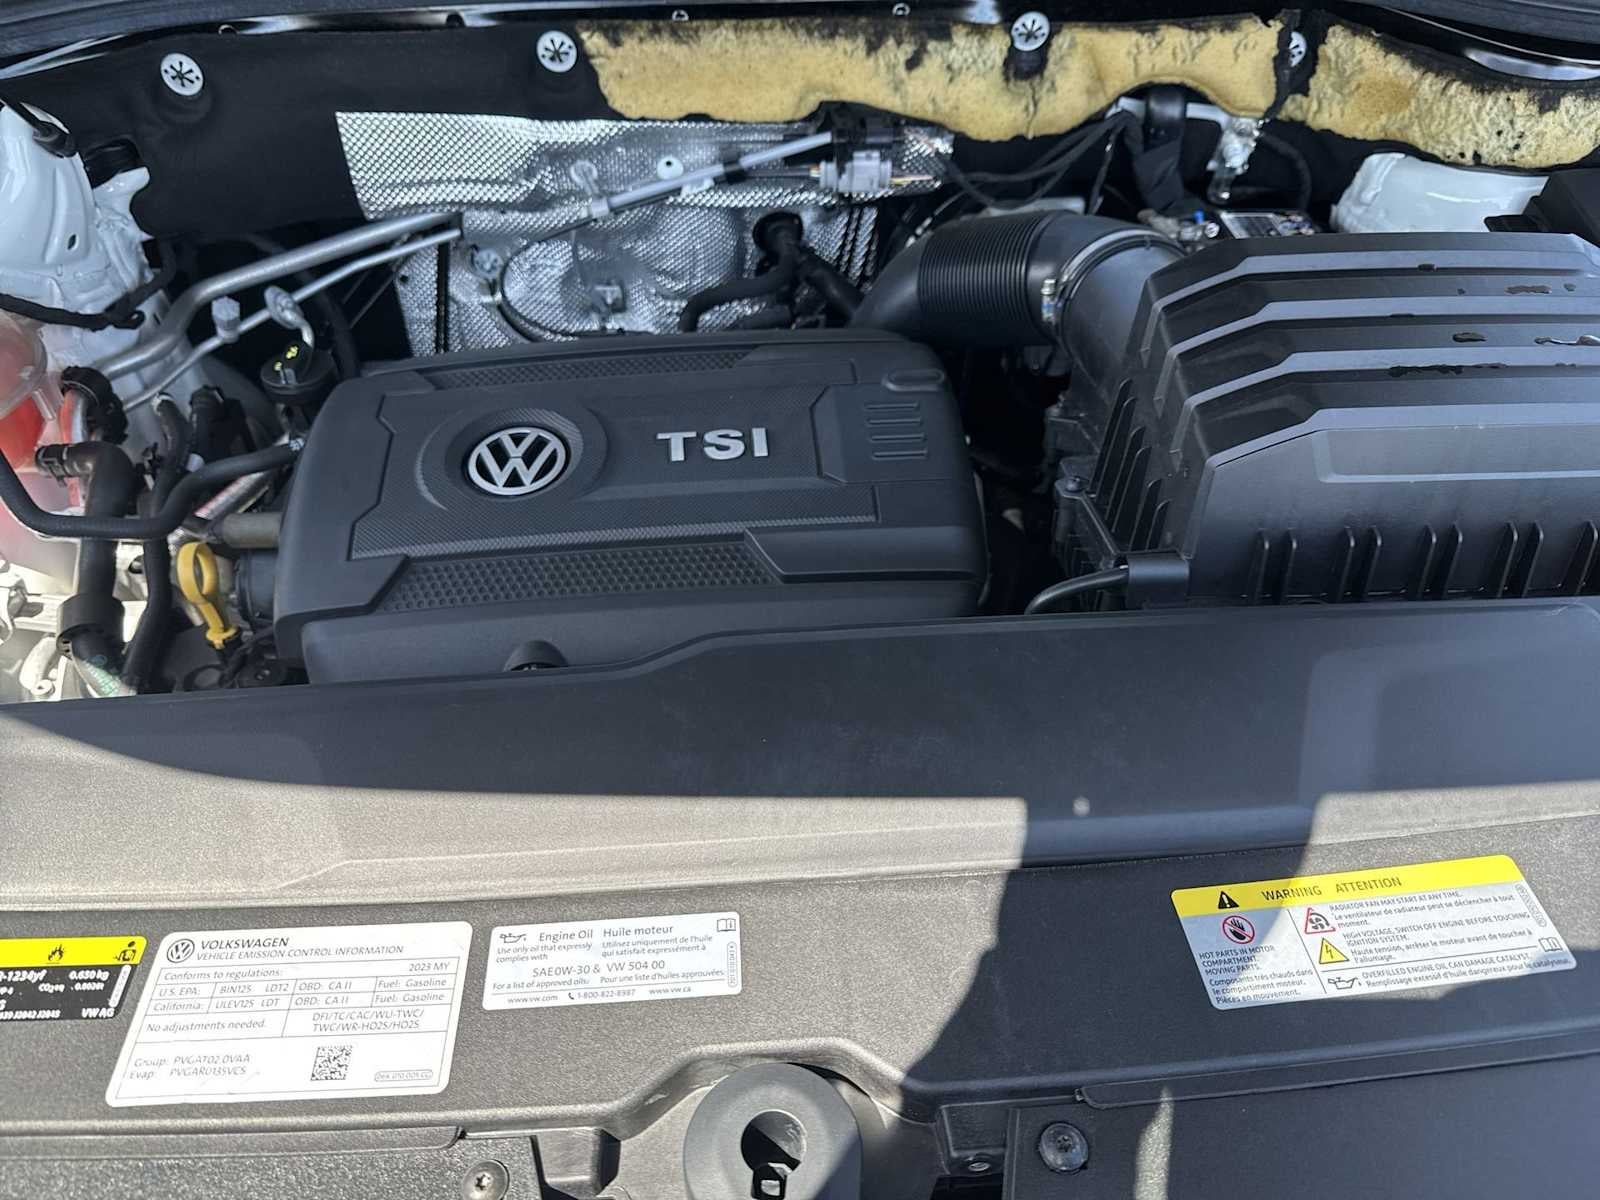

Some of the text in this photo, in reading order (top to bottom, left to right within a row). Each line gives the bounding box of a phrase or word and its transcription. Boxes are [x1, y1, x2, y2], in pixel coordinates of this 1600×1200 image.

[656, 427, 768, 461] TSI
[1261, 877, 1402, 901] WARNING ATTENTION
[1329, 890, 1462, 912] RADIATOR FAN MAY START AT ANY TIME.
[1343, 909, 1382, 920] ventilateur
[1394, 904, 1427, 914] radiateur
[1427, 903, 1445, 912] peut
[1454, 897, 1492, 907] déclencher
[1500, 894, 1515, 902] tout
[603, 925, 674, 937] Huile moteur
[1337, 920, 1370, 929] moment.
[1344, 932, 1359, 940] HIGH
[1396, 924, 1423, 934] SWITCH
[1424, 922, 1437, 931] OFF
[1438, 919, 1464, 929] ENGINE
[1465, 915, 1492, 926] BEFORE
[1493, 911, 1530, 922] TOUCHING
[539, 929, 593, 943] Engine Oil
[602, 935, 713, 949] Utilisez uniquement de l'huile
[1347, 935, 1409, 947] IGNITION SYSTEM.
[201, 937, 289, 950] VOLKSWAGEN
[497, 942, 593, 955] Use only oil that expressly
[1350, 949, 1373, 957] Haute
[1374, 945, 1404, 955] tension,
[1405, 941, 1431, 951] arrêter
[1439, 937, 1465, 946] moteur
[1467, 935, 1487, 943] avant
[1488, 933, 1497, 941] de
[1498, 930, 1526, 940] toucher
[197, 945, 404, 961] VEHICLE EMISSION CONTROL INFORMATION
[602, 943, 707, 958] qui satisfait expressément à
[1199, 951, 1214, 960] HOT
[1215, 949, 1239, 958] PARTS
[1249, 945, 1275, 954] MOTOR
[496, 953, 549, 965] complies with
[1362, 952, 1530, 978] OVERFILLED ENGINE OIL CAN DAMAGE CATALYST.
[409, 961, 450, 972] 2023 MY
[592, 964, 601, 974] &
[606, 962, 625, 973] VW
[628, 961, 649, 971] 504
[651, 960, 666, 970] 00
[96, 969, 110, 982] kg
[164, 970, 211, 981] Conforms
[213, 970, 224, 979] to
[600, 976, 617, 984] Pour
[618, 974, 634, 983] une
[635, 973, 650, 981] liste
[651, 971, 680, 981] d'huiles
[1209, 975, 1254, 987] Composants
[1269, 970, 1295, 980] chauds
[1295, 968, 1313, 976] dans
[219, 982, 289, 995] BIN125 LDT2
[298, 982, 323, 992] OBD:
[328, 980, 343, 991] CA
[378, 978, 447, 989] Fuel: Gasoline
[492, 982, 504, 990] For
[513, 981, 525, 989] list
[526, 980, 534, 988] of
[535, 979, 572, 990] approved
[1212, 979, 1307, 996] le compartiment moteur.
[215, 999, 255, 1010] ULEV125
[261, 998, 280, 1008] LDT
[294, 996, 321, 1006] OBD:
[324, 995, 339, 1005] CA
[375, 993, 445, 1004] Fuel: Gasoline
[507, 994, 558, 1004] www.vw.com
[82, 1007, 99, 1018] VW
[99, 1007, 115, 1018] AG
[146, 1019, 266, 1034] No adjustments needed.
[134, 1058, 168, 1069] Group:
